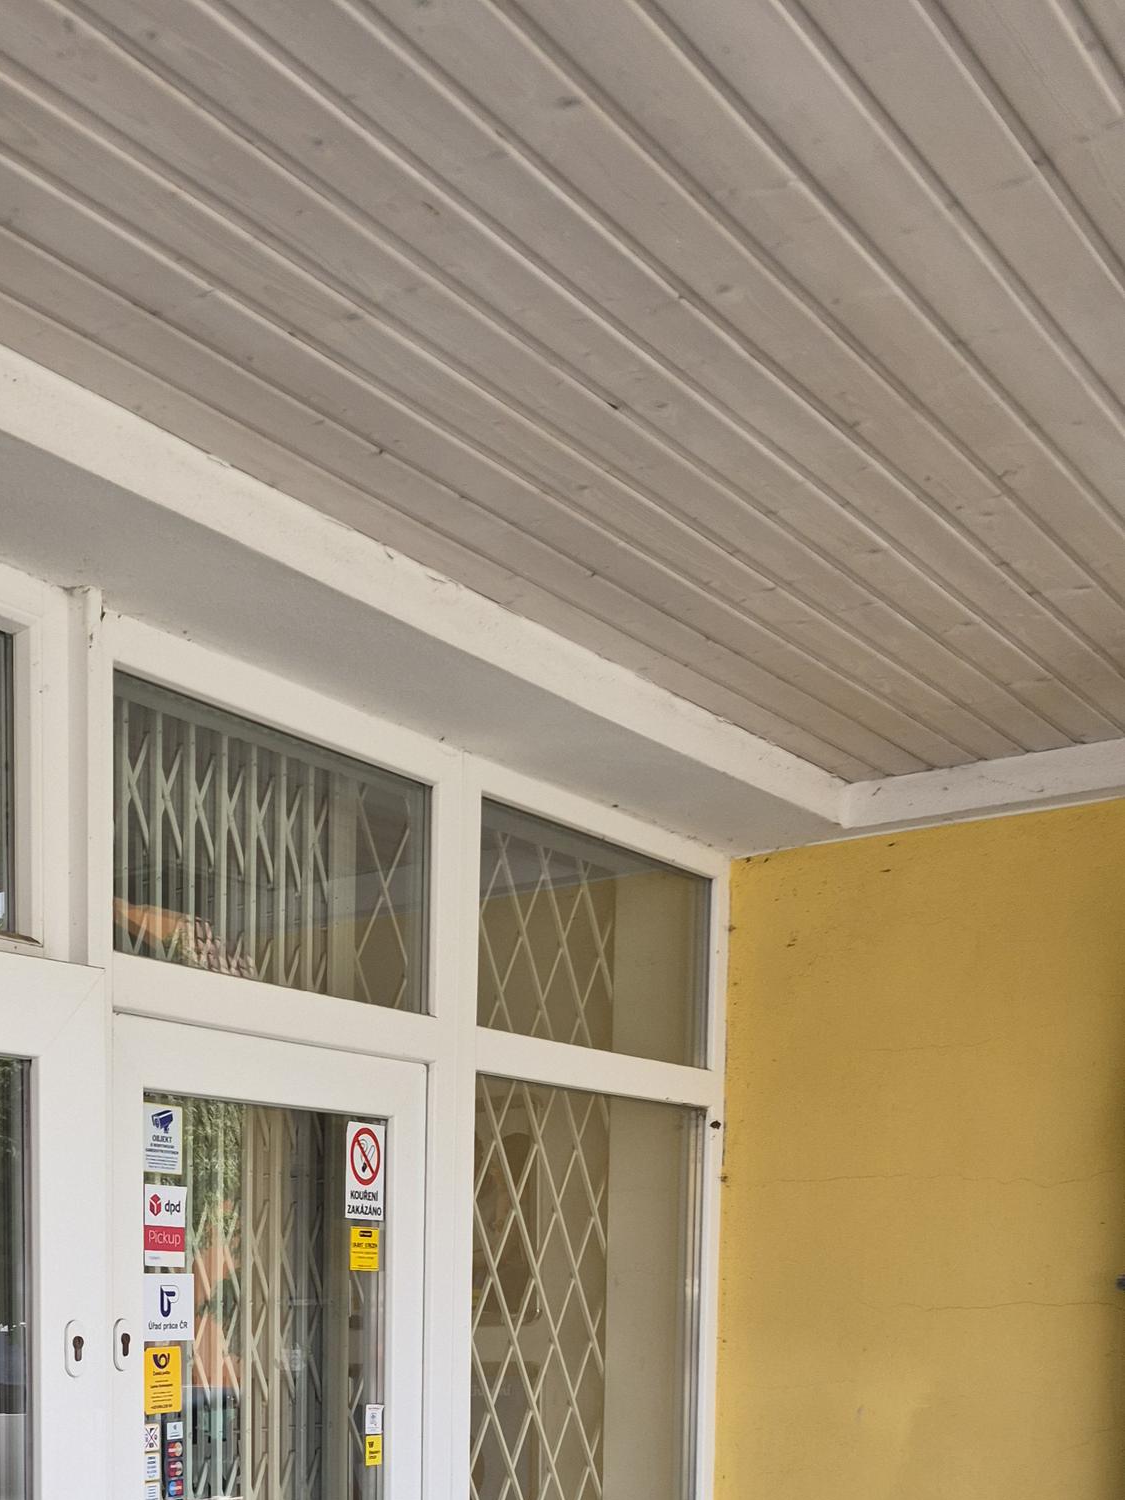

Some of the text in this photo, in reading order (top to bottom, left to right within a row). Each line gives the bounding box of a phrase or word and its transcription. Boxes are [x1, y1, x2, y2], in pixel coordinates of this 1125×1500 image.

[350, 1190, 379, 1202] KOUŘENÍ
[164, 1200, 181, 1215] dpd
[347, 1203, 382, 1216] ZAKÁZÁNO
[148, 1230, 181, 1247] Pickup
[148, 1320, 162, 1330] Úřad
